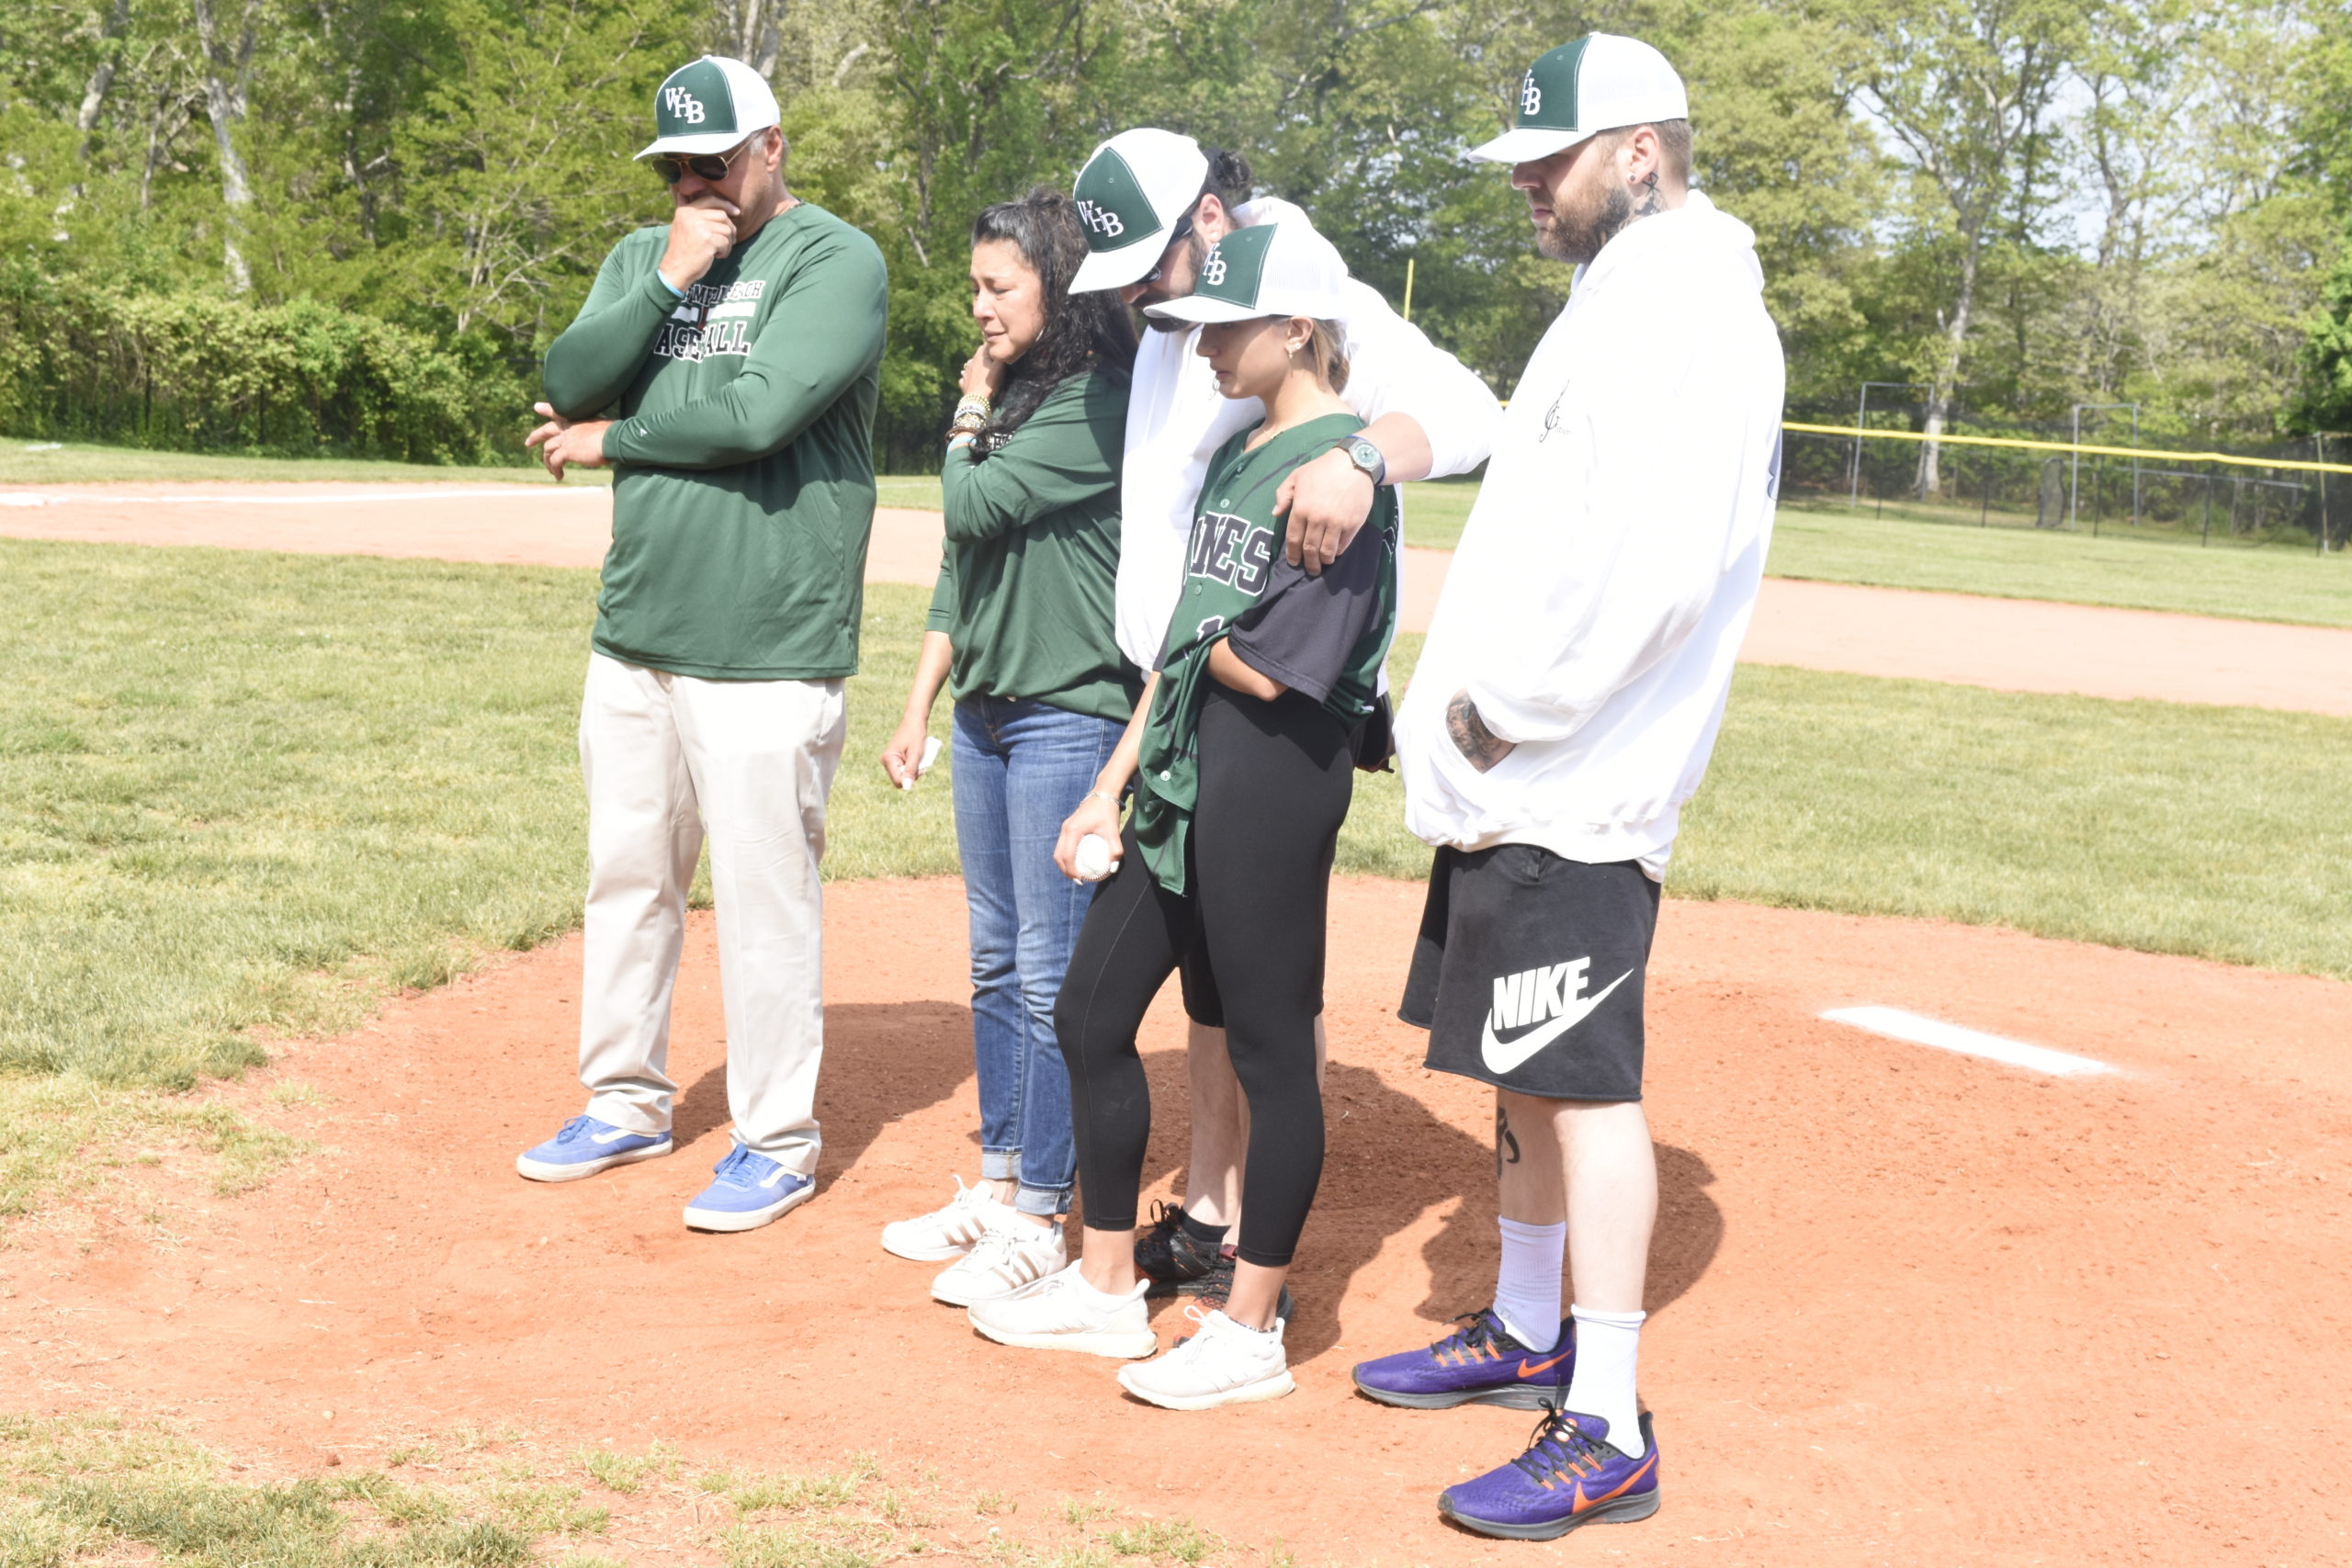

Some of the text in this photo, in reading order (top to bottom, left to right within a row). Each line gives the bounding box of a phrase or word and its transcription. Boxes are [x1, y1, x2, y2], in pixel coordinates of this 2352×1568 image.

[664, 86, 706, 124] WHB
[1521, 68, 1542, 116] HB
[1077, 199, 1125, 238] WHB
[1189, 510, 1275, 597] NES
[1493, 955, 1591, 1031] NIKE
